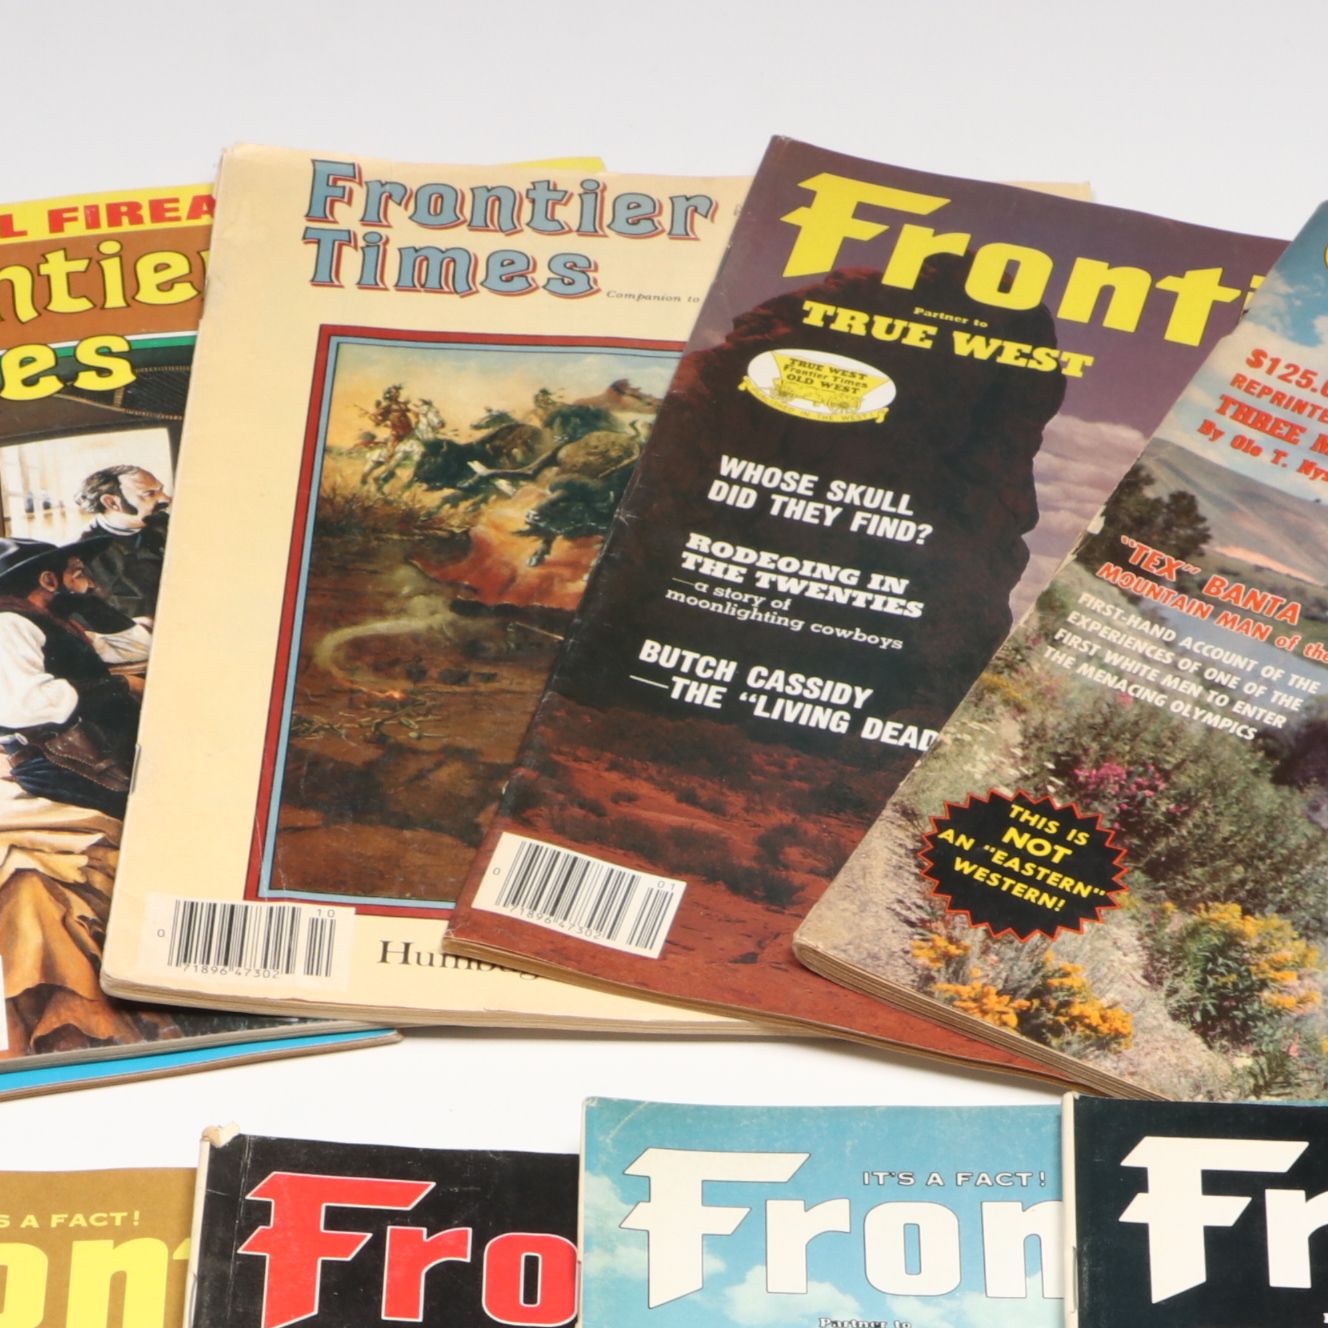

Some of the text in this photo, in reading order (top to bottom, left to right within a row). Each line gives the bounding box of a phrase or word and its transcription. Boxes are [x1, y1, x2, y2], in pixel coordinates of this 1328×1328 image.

[304, 159, 718, 240] Frontier
[302, 226, 601, 297] Times
[606, 290, 682, 302] Companion
[914, 307, 989, 328] Partner to
[802, 301, 1094, 377] TRUE WEST
[1216, 395, 1301, 446] THREE
[708, 480, 932, 545] DID THEY FIND?
[720, 455, 914, 516] WHOSE SKULL
[681, 552, 924, 618] THE TWENTIES
[685, 533, 909, 595] RODEOING IN
[665, 589, 904, 650] moonlighting cowboys
[1096, 562, 1214, 620] MOUNTAIN
[1215, 612, 1273, 641] MAN
[1274, 634, 1303, 651] of
[639, 639, 873, 709] BUTCH CASSIDY
[938, 829, 975, 850] AN
[1002, 827, 1072, 864] NOT
[1010, 804, 1090, 846] THIS IS
[953, 858, 1066, 912] WESTERN!
